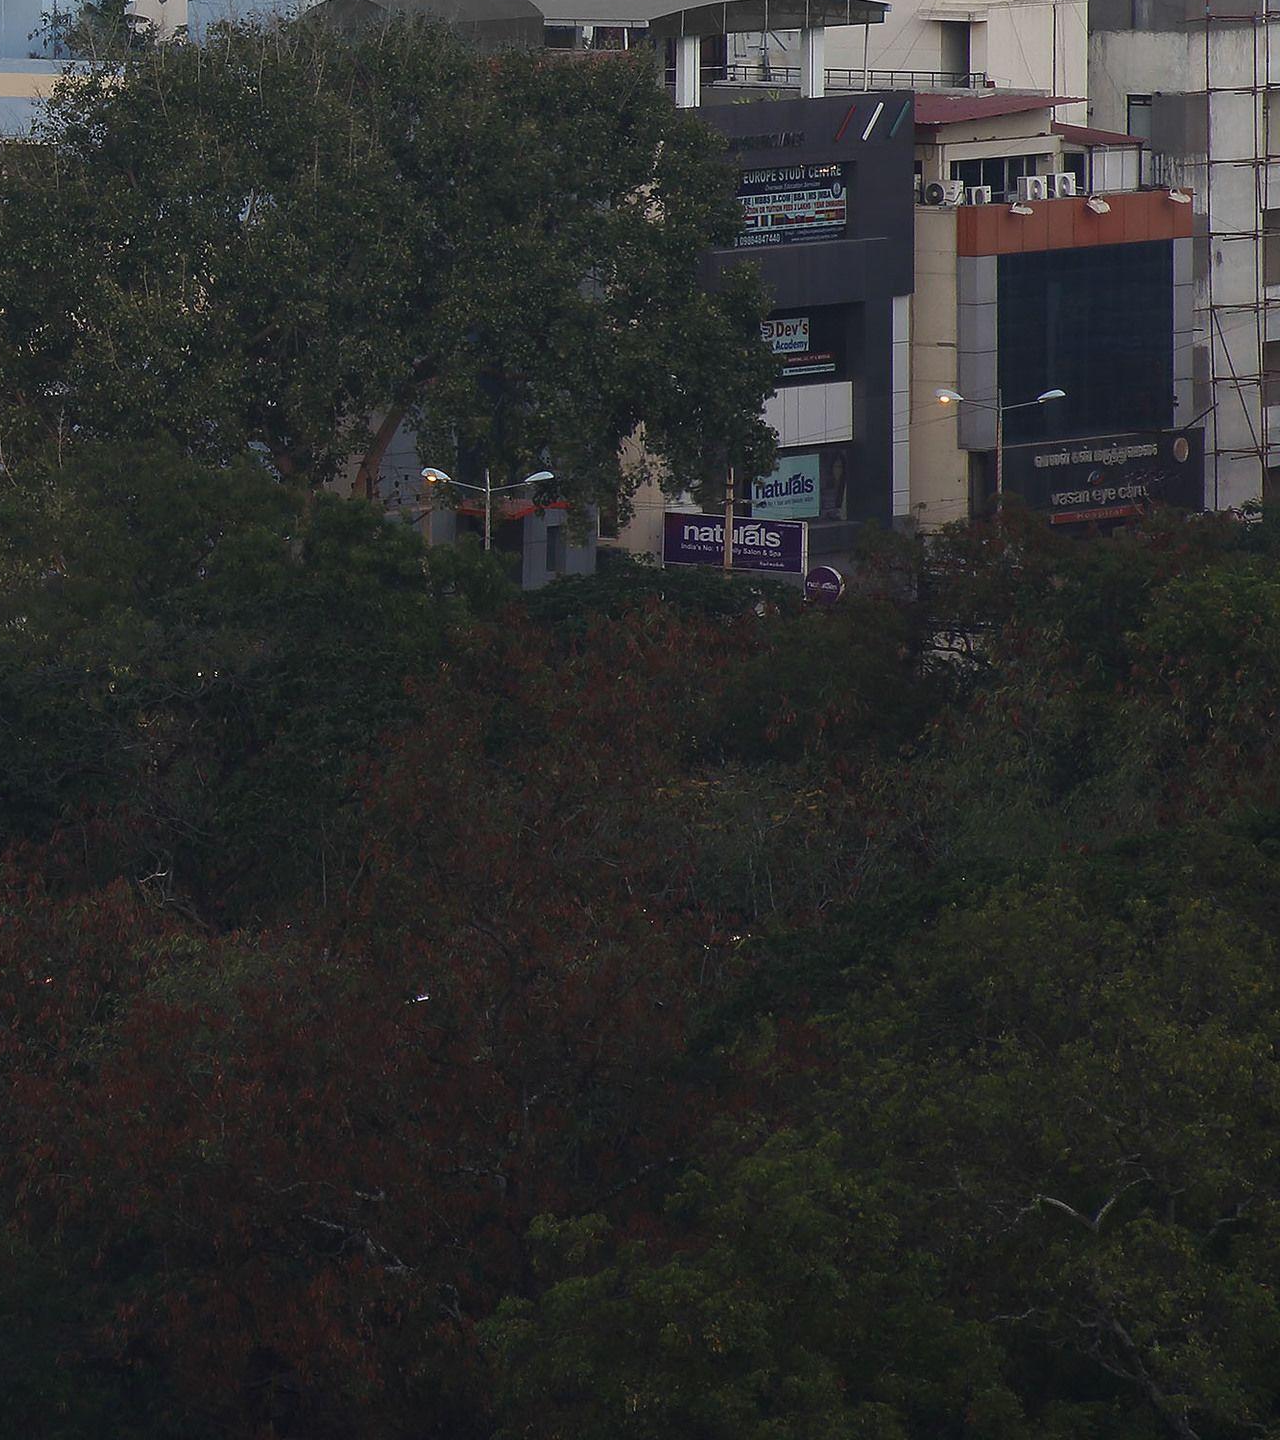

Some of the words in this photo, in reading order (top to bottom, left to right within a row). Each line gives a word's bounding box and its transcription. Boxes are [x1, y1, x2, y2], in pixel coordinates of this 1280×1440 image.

[743, 169, 777, 185] EUROPE
[779, 165, 807, 181] STUDY
[776, 319, 809, 337] Dev's
[776, 339, 809, 350] Academy
[756, 472, 814, 499] naturals
[1051, 489, 1090, 505] vasan
[1091, 488, 1116, 505] eye
[743, 547, 762, 557] Salon
[769, 549, 782, 559] Spa
